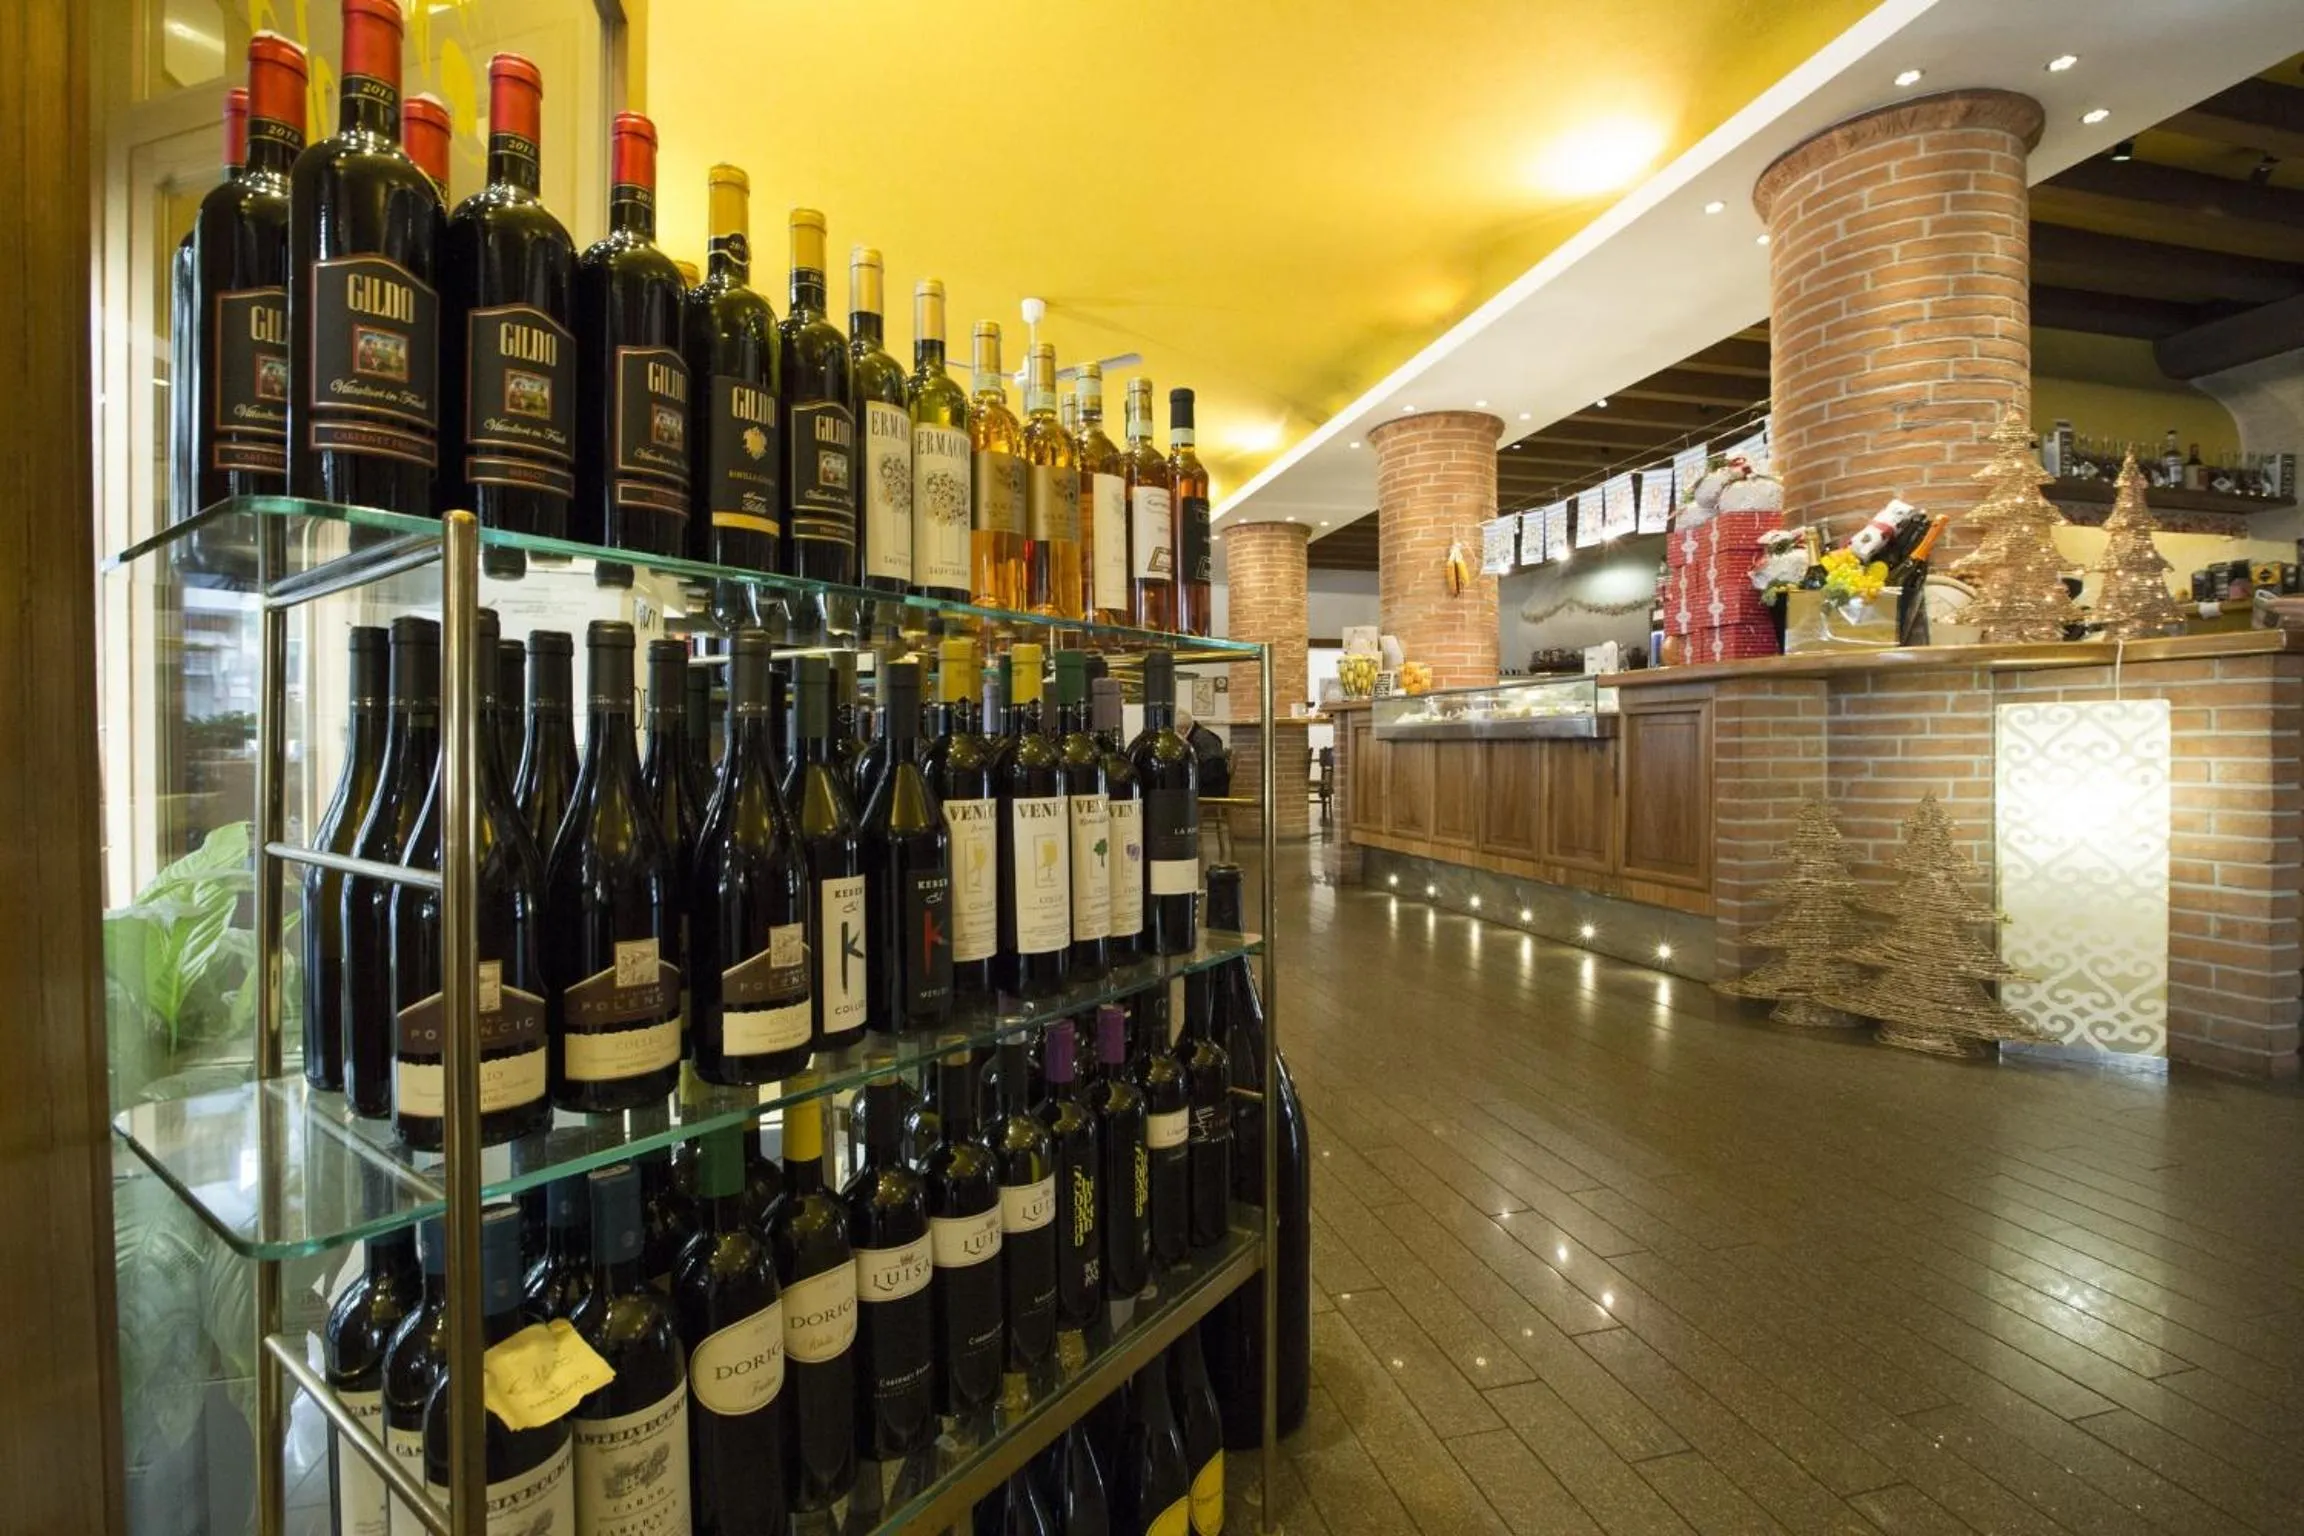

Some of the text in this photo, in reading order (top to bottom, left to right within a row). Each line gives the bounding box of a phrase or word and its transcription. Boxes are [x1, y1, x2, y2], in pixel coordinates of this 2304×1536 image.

[347, 273, 415, 324] GILDO
[500, 322, 557, 367] GILDO
[732, 386, 776, 428] GILDO
[410, 1018, 535, 1041] PONCIC
[872, 1262, 932, 1292] LUISA
